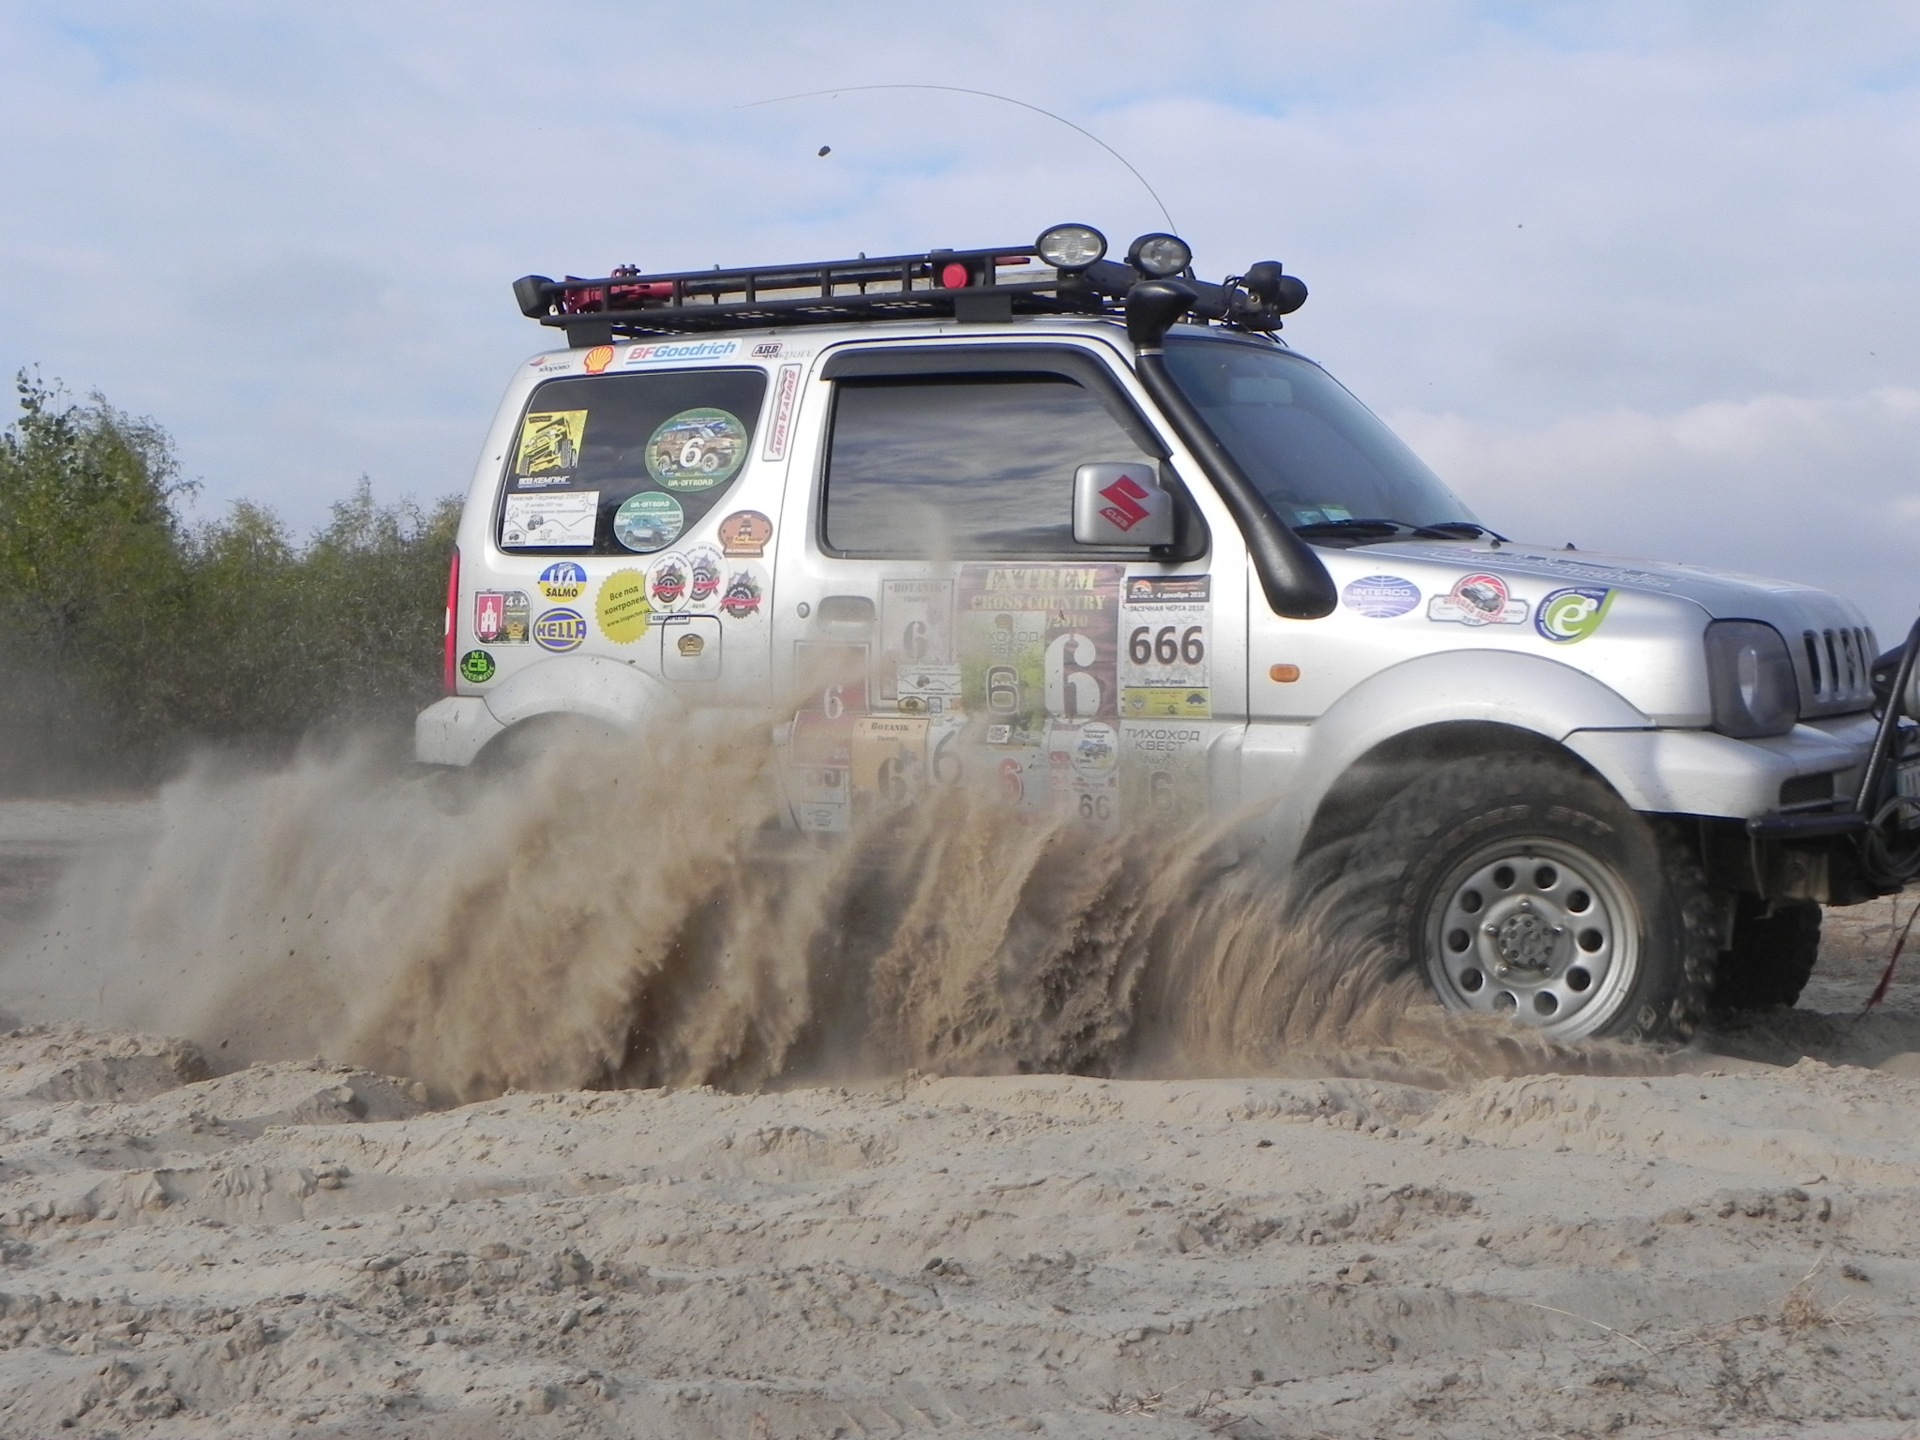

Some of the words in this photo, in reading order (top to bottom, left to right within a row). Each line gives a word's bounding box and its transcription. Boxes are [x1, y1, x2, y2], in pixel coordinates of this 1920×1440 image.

[628, 341, 737, 360] BFGoodrich
[755, 345, 780, 355] ARB
[680, 437, 705, 468] 6
[1106, 509, 1129, 528] CLUB
[548, 569, 579, 587] UA
[985, 568, 1099, 591] EXTREM
[546, 588, 578, 597] SALMO
[609, 591, 623, 601] Все
[624, 585, 639, 596] под
[1352, 588, 1411, 596] INTERCO
[604, 595, 645, 615] контролем
[971, 595, 1023, 610] CROSS
[1026, 595, 1107, 610] COUNTRY
[536, 620, 587, 639] HELLA
[903, 620, 929, 660] 6
[1128, 625, 1205, 665] 666
[467, 659, 488, 672] CB
[1044, 633, 1101, 725] 6
[986, 665, 1020, 716] 6
[824, 684, 844, 719] 6
[1125, 728, 1200, 742] ТИХОХОД
[1135, 741, 1186, 752] КВЕСТ
[932, 730, 964, 785] 6
[877, 756, 908, 801] 6
